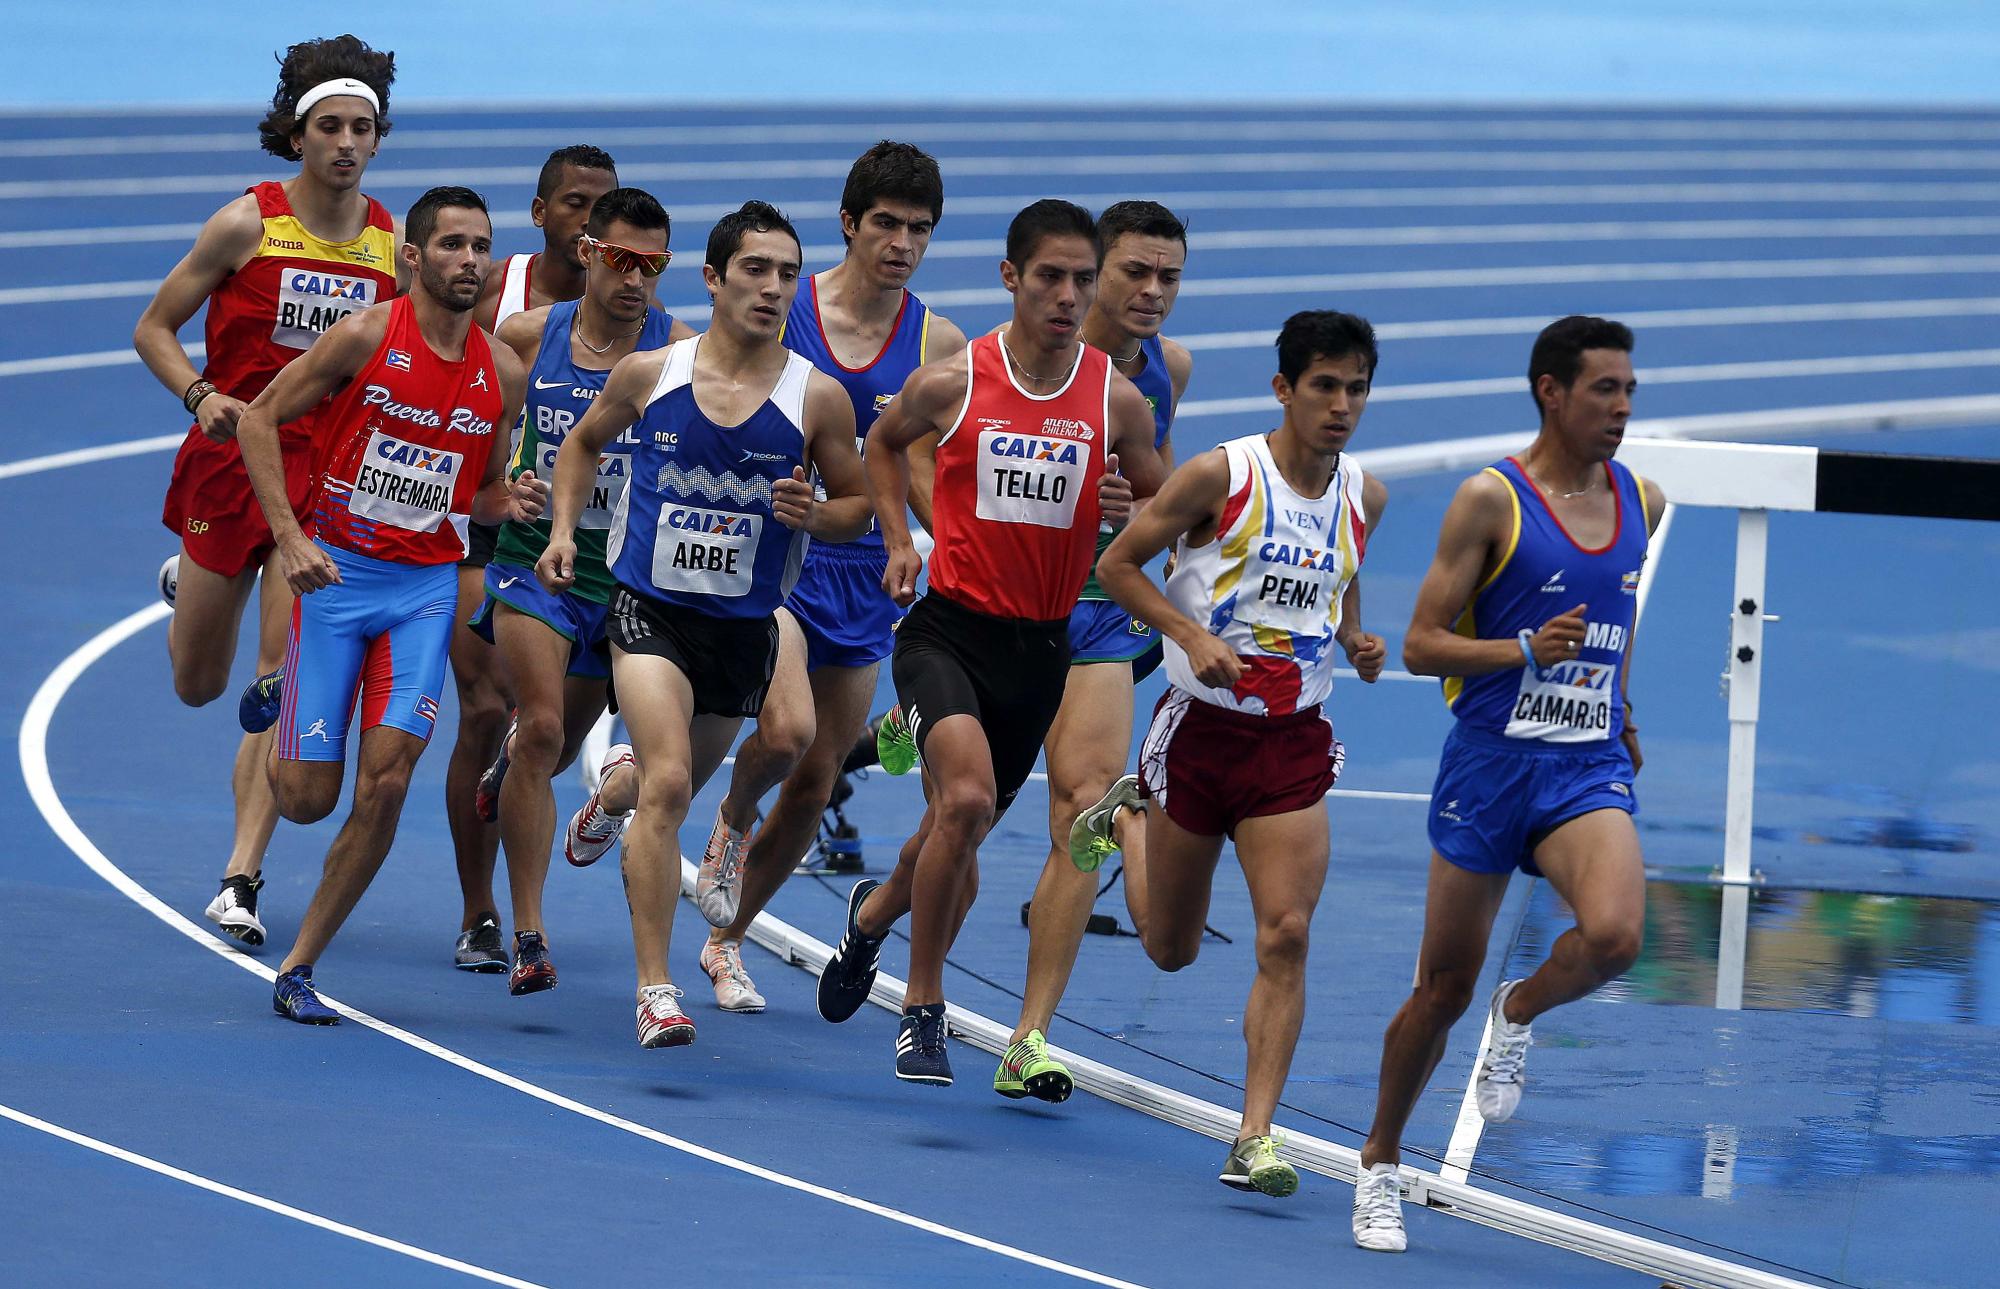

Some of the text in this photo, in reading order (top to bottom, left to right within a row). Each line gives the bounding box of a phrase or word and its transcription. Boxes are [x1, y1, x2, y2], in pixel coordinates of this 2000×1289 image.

[291, 273, 366, 301] CAIXA
[363, 384, 493, 435] Puerto Rico
[1041, 425, 1078, 437] CHILENA
[377, 440, 453, 474] CAIXA
[990, 436, 1077, 465] CAIXA
[356, 464, 450, 514] ESTREMARA
[993, 468, 1067, 504] TELLO
[668, 509, 752, 537] CAIXA
[1285, 509, 1324, 531] VEN
[672, 541, 740, 575] ARBE
[1259, 542, 1334, 573] CAIXA
[1259, 574, 1319, 610] PENA
